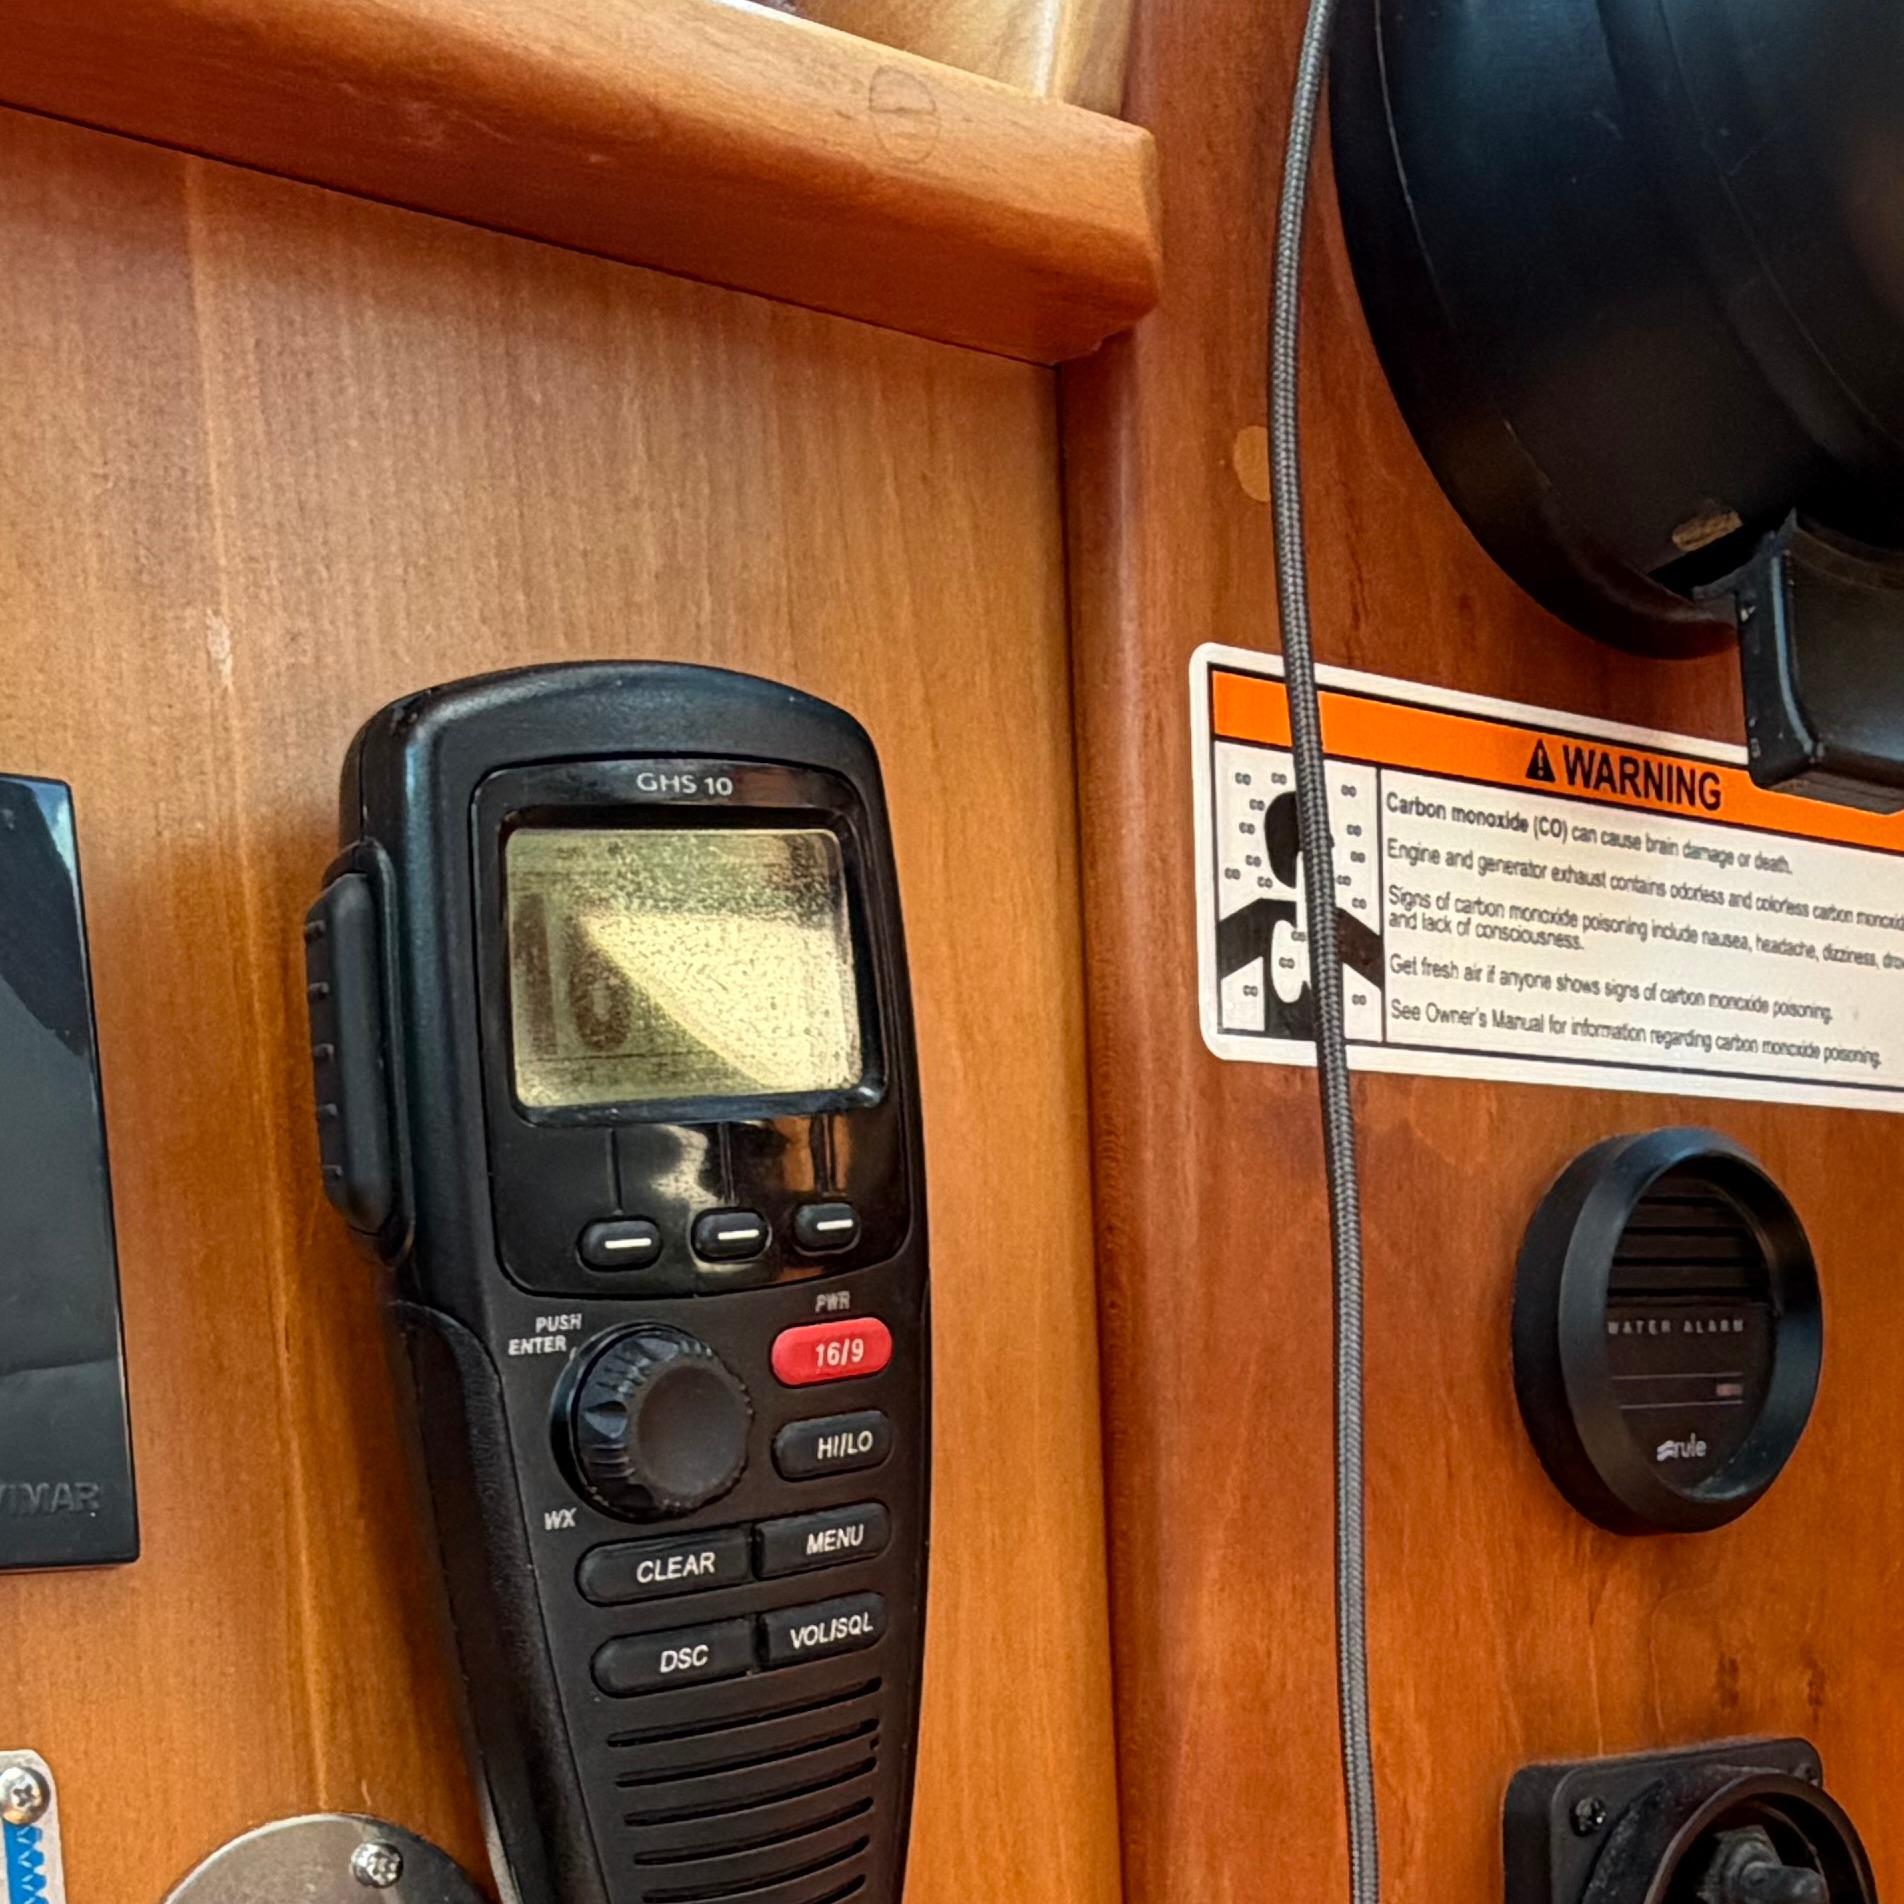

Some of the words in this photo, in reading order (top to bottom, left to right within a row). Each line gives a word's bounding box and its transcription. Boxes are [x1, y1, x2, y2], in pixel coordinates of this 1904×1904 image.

[636, 772, 697, 795] GHS
[703, 776, 734, 798] 10
[1563, 744, 1721, 811] WARNING
[1386, 791, 1446, 820] Carbon
[1451, 806, 1529, 833] monoxide
[1533, 815, 1568, 844] (CO)
[1571, 825, 1597, 843] can
[1601, 831, 1641, 852] cause
[1646, 832, 1679, 856] brain
[1683, 839, 1734, 869] damage
[1737, 853, 1751, 868] or
[1387, 838, 1441, 866] Engine
[1445, 850, 1473, 869] and
[1478, 856, 1548, 880] generator
[1551, 864, 1606, 888] exhaust
[1610, 872, 1666, 898] contains
[1670, 882, 1725, 906] odorless
[1728, 890, 1752, 910] and
[1756, 895, 1810, 918] colorless
[1388, 884, 1431, 911] Signs
[1436, 891, 1450, 910] of
[1454, 896, 1505, 919] carbon
[1509, 903, 1578, 928] monoxide
[1582, 912, 1648, 942] poisoning
[1651, 919, 1698, 944] include
[1701, 928, 1752, 952] nausea,
[1388, 911, 1417, 930] and
[1421, 912, 1452, 934] lack
[1457, 917, 1471, 936] of
[1475, 920, 1584, 950] consciousness.
[1390, 953, 1418, 976] Get
[1421, 956, 1459, 980] fresh
[1464, 962, 1481, 982] air
[1486, 964, 1496, 984] if
[1499, 969, 1552, 992] anyone
[1556, 973, 1600, 996] shows
[1604, 978, 1639, 1003] signs
[1643, 982, 1658, 1002] of
[1660, 985, 1705, 1006] carbon
[1708, 992, 1769, 1014] monoxide
[1772, 997, 1833, 1025] poisoning.
[1390, 998, 1421, 1021] See
[1425, 1001, 1487, 1028] Owner's
[1492, 1008, 1544, 1033] Manual
[1549, 1014, 1568, 1034] for
[1571, 1017, 1646, 1042] information
[1650, 1028, 1712, 1051] regarding
[815, 1291, 850, 1313] PWR
[535, 1313, 582, 1333] PUSH
[1607, 1319, 1671, 1336] WATER
[1683, 1318, 1744, 1334] ALARM
[508, 1336, 566, 1356] ENTER
[815, 1337, 865, 1369] 16/9
[817, 1430, 873, 1460] HI/LO
[1673, 1433, 1707, 1459] rule
[543, 1507, 576, 1530] WX
[805, 1524, 865, 1555] MENU
[636, 1552, 716, 1584] CLEAR
[789, 1612, 873, 1649] VOL/SQL
[660, 1644, 709, 1674] DSC
